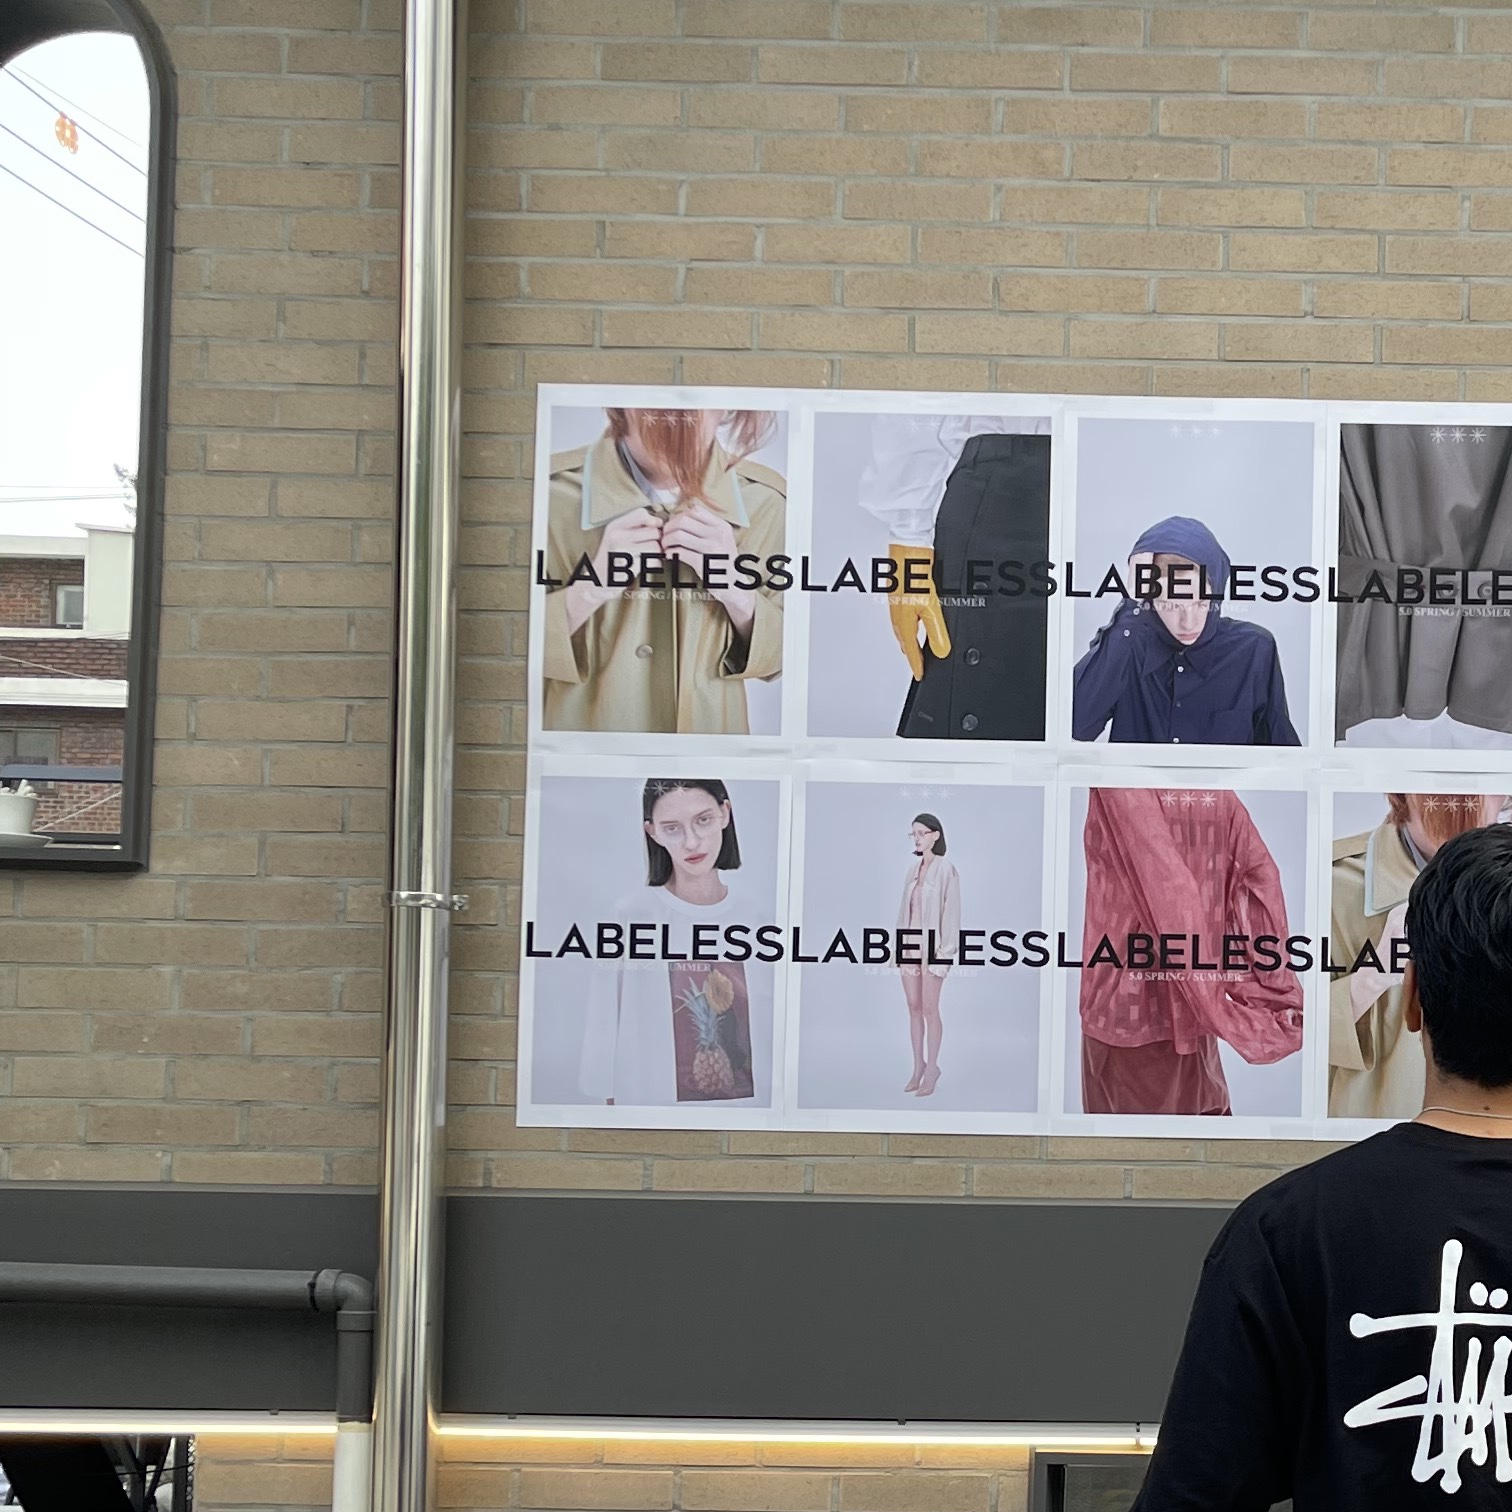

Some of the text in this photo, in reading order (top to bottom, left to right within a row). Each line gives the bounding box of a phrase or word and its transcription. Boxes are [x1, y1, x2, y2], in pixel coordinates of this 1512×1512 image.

[536, 550, 794, 591] LABELESS
[801, 556, 1058, 597] LABELESS
[1065, 561, 1320, 602] LABELESS
[937, 598, 986, 607] SUMMER
[1414, 607, 1455, 616] SPRING
[1463, 608, 1511, 617] SUMMER
[526, 921, 784, 962] LABELESS
[792, 926, 1050, 967] LABELESS
[1058, 932, 1313, 972] LABELESS
[664, 962, 711, 972] UMMER
[1128, 972, 1142, 981] 5.0
[1144, 972, 1185, 981] SPRING
[1193, 973, 1242, 982] SUMMER
